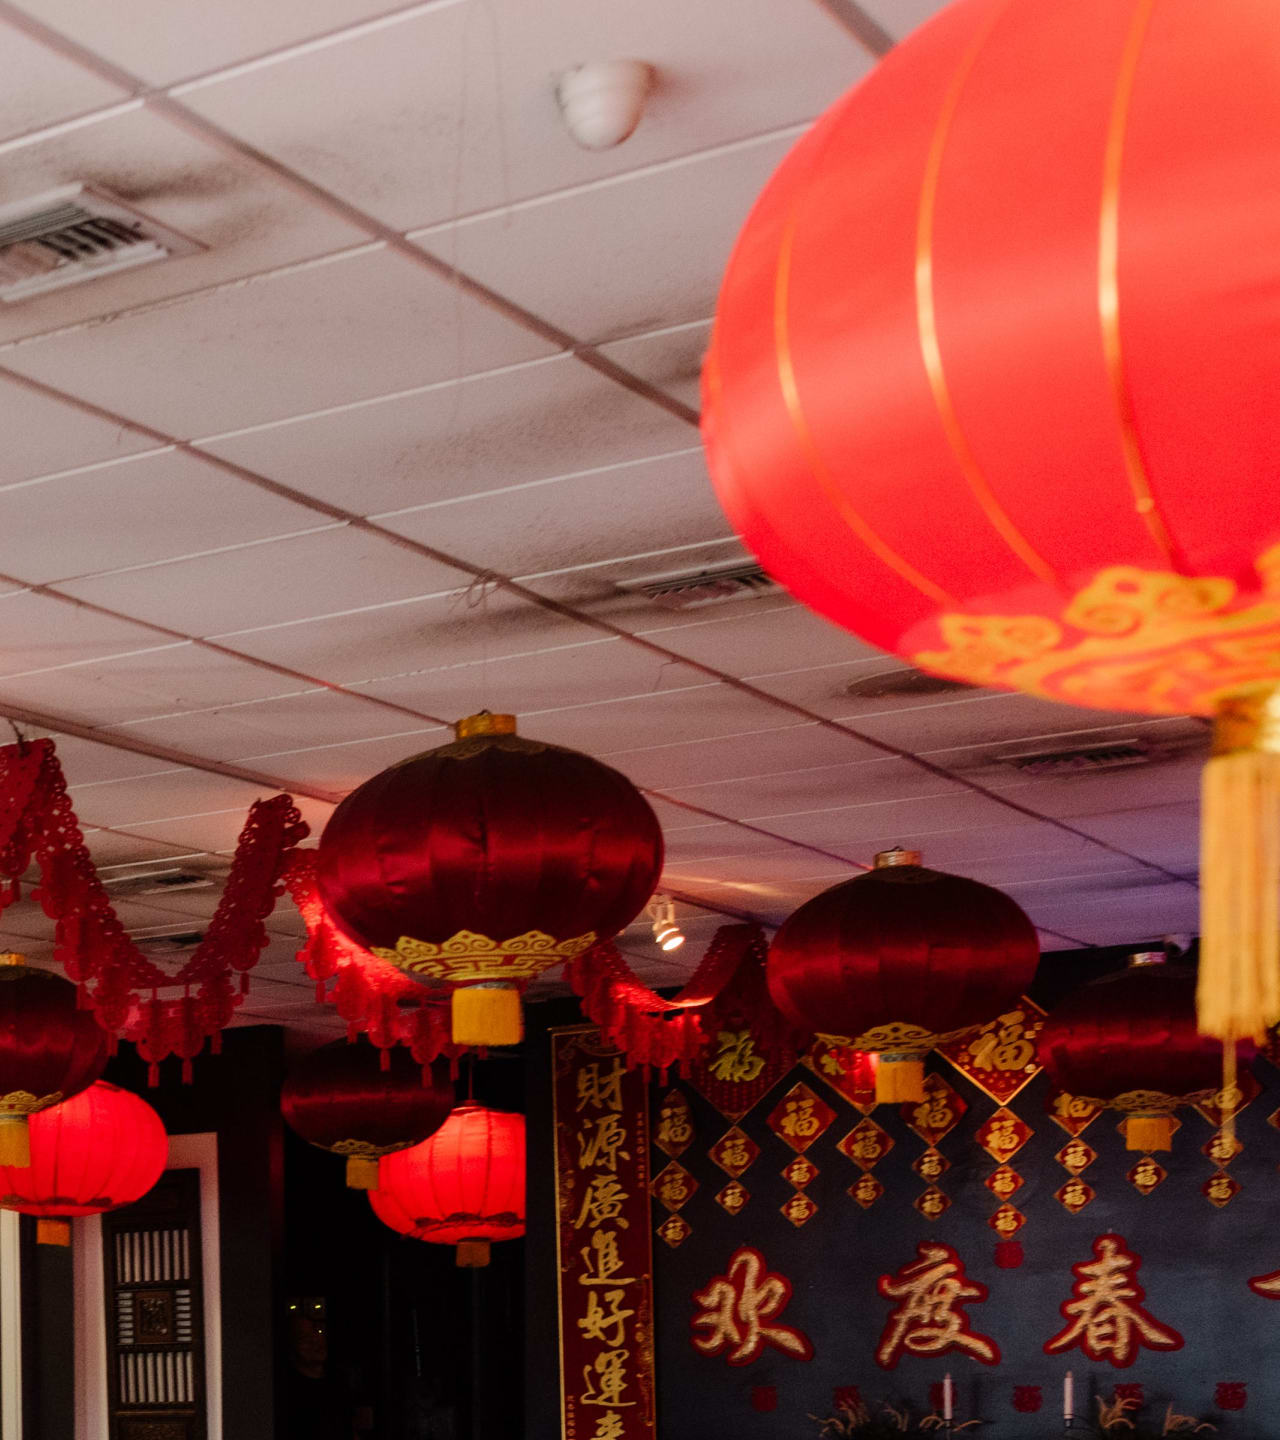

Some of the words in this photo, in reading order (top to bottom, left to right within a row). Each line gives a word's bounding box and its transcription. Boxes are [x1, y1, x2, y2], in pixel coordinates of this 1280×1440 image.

[968, 1011, 1034, 1072] 福
[709, 1030, 765, 1082] 福
[780, 1099, 820, 1136] 福
[913, 1089, 953, 1128] 福
[658, 1106, 690, 1142] 福
[986, 1120, 1020, 1149] 福
[720, 1138, 750, 1166] 福
[851, 1131, 881, 1159] 福
[921, 1155, 942, 1176] 福
[1065, 1146, 1088, 1167] 福
[789, 1162, 810, 1183] 福
[993, 1173, 1015, 1193] 福
[1134, 1165, 1158, 1186] 福
[660, 1173, 688, 1200] 福
[856, 1181, 877, 1200] 福
[1064, 1185, 1086, 1206] 福
[1208, 1178, 1232, 1199] 福
[723, 1188, 744, 1207] 福
[921, 1192, 943, 1213] 福
[789, 1199, 810, 1219] 福
[663, 1220, 685, 1240] 福
[995, 1211, 1018, 1231] 福
[691, 1235, 1280, 1367] 欢度春
